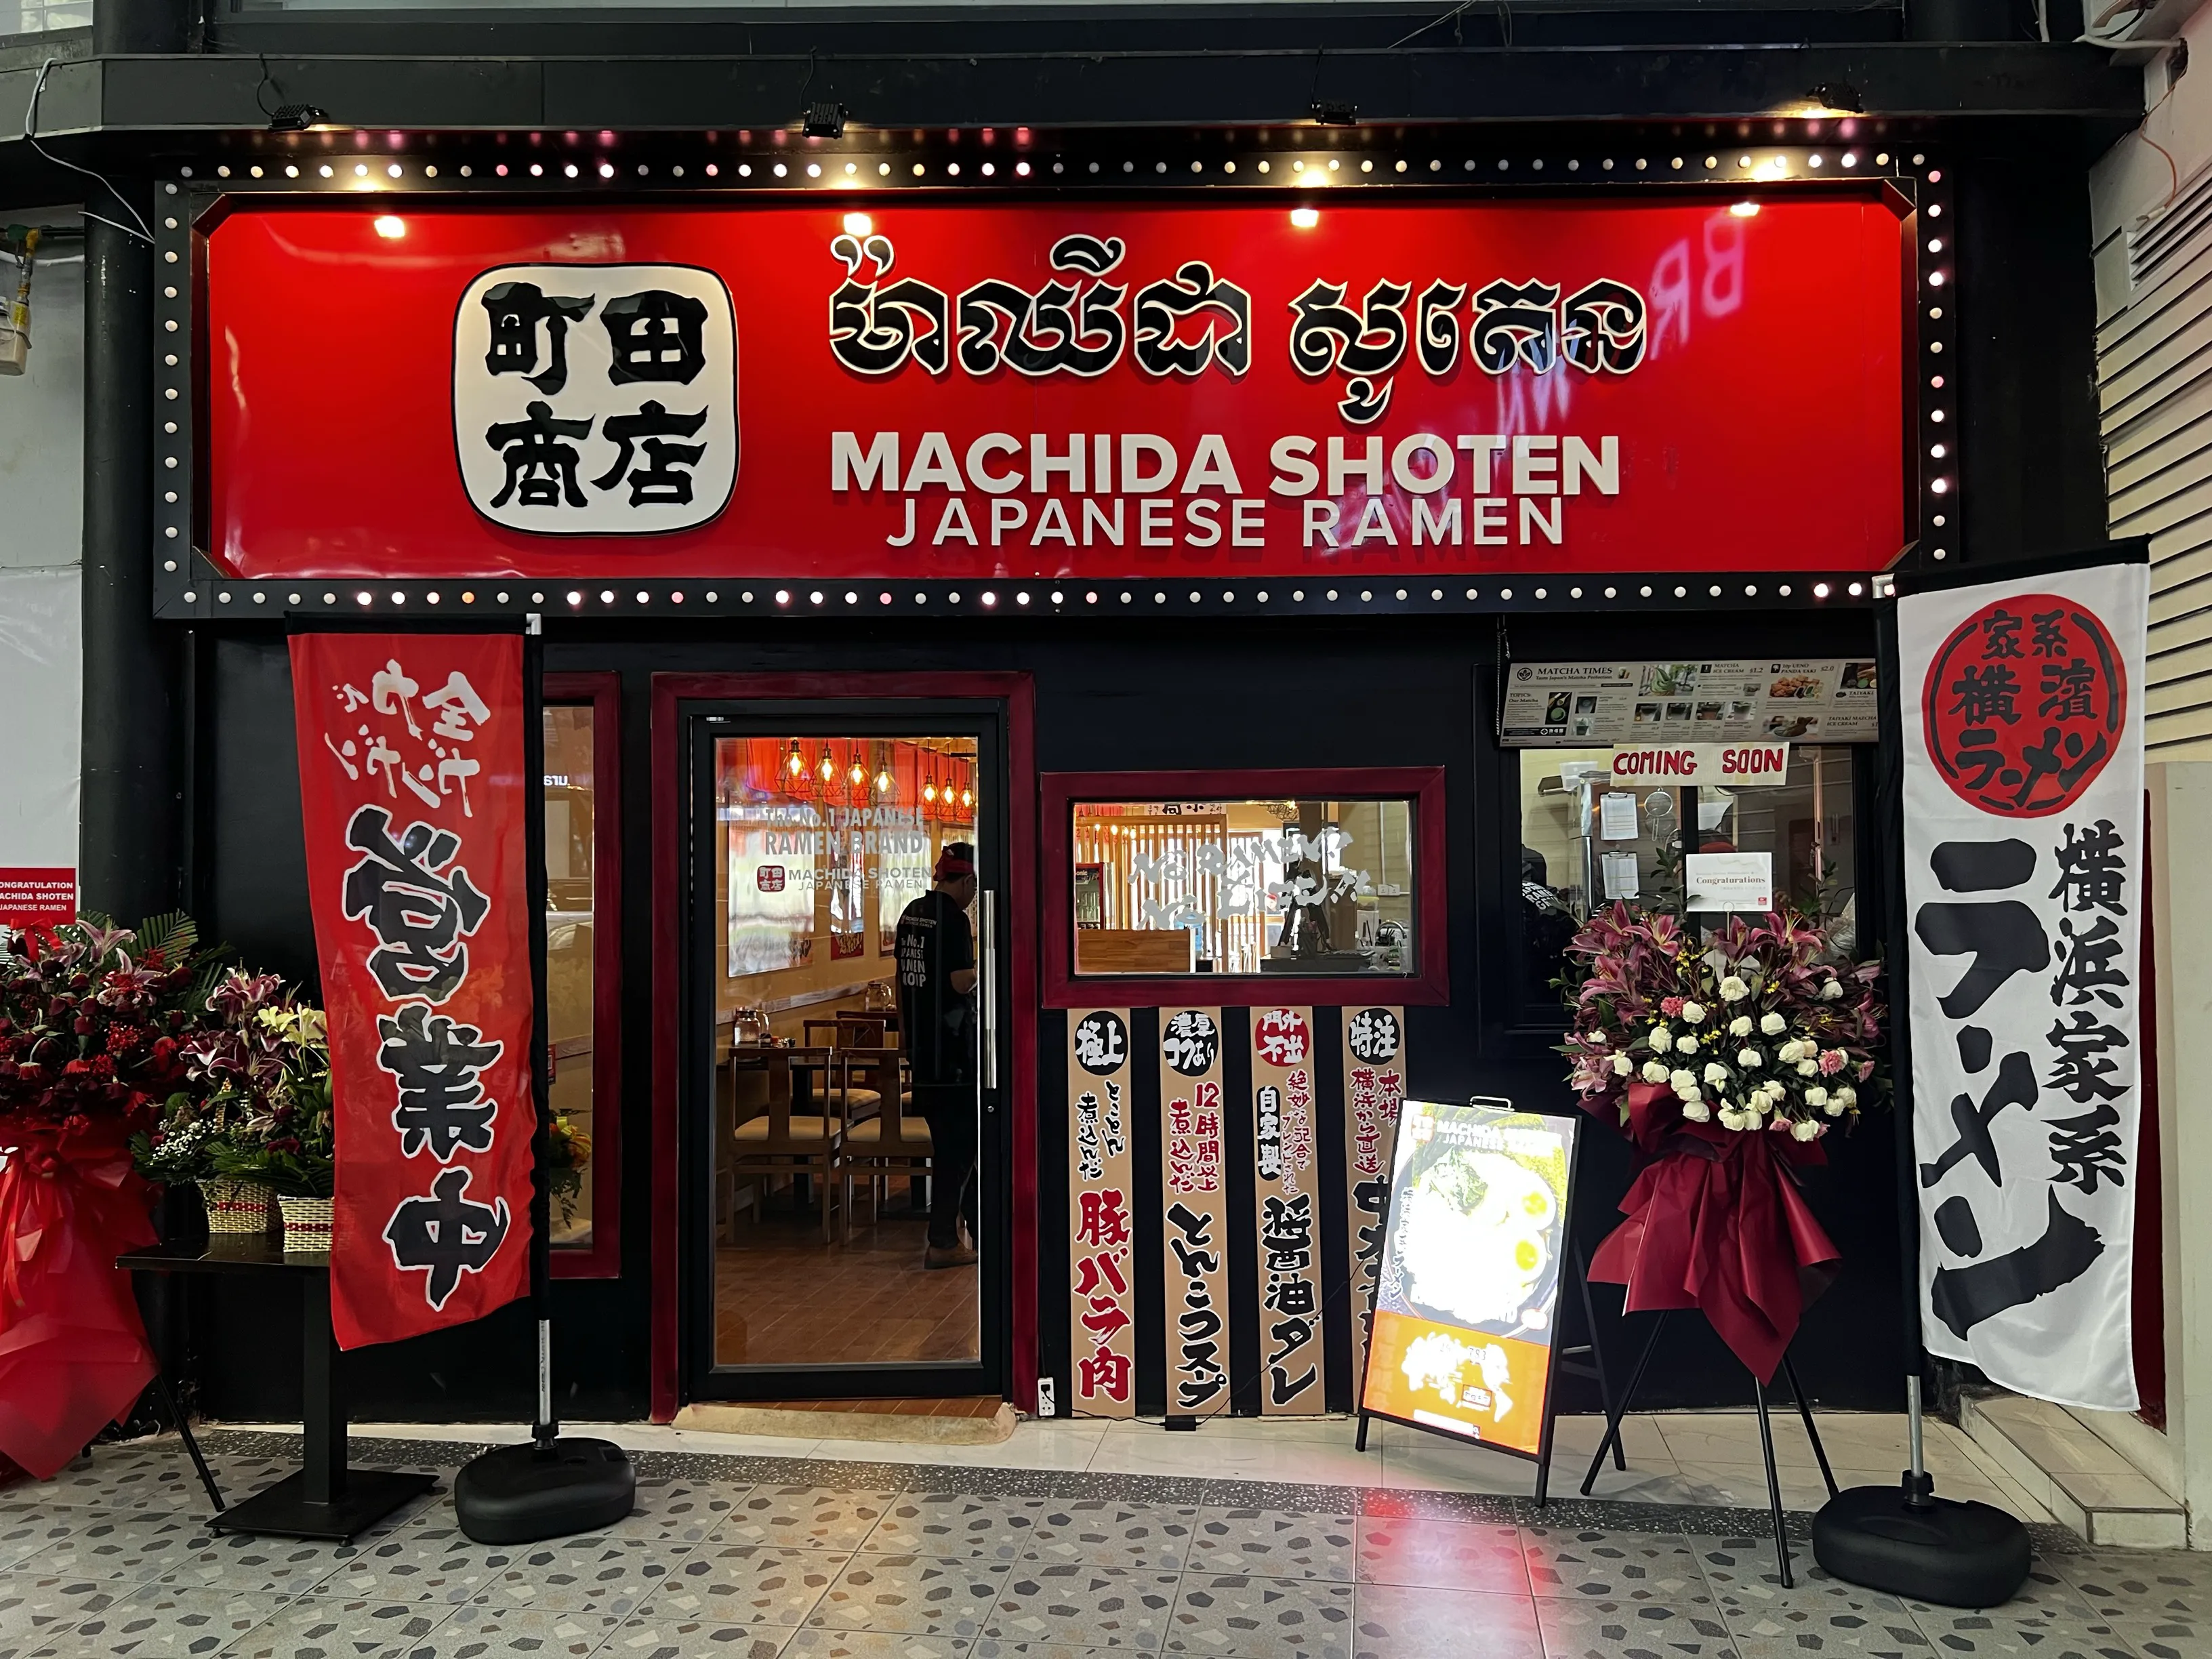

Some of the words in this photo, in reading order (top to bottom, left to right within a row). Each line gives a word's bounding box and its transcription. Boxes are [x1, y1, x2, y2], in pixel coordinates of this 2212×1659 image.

[480, 282, 708, 396] 町田
[485, 400, 709, 509] 商店
[832, 432, 1242, 493] MACHIDA
[1269, 434, 1620, 496] SHOTEN
[886, 499, 1265, 547] JAPANESE
[1303, 497, 1562, 548] RAMEN
[1981, 609, 2069, 660] 家系
[1948, 658, 2098, 726] 横濱
[1613, 749, 1698, 775] COMING
[1722, 748, 1784, 774] SOON
[1954, 726, 2107, 807] ラーメン
[765, 831, 840, 855] RAMEN
[851, 830, 923, 855] BRAND
[799, 806, 835, 827] No.1
[843, 805, 923, 828] JAPANESE
[789, 869, 861, 882] MACHIDA
[868, 867, 931, 879] SHOTEN
[798, 880, 869, 890] JAPANESE
[876, 879, 922, 889] RAMEN
[907, 935, 925, 949] No.1
[1170, 1012, 1215, 1037] 濃厚
[1262, 1010, 1303, 1031] 門外
[1349, 1012, 1398, 1058] 特注
[2040, 819, 2134, 1195] 横浜家系
[1076, 1021, 1124, 1065] 極上
[1257, 1034, 1303, 1063] 不出
[1914, 838, 2106, 1342] ラーメン
[1076, 1092, 1103, 1181] 煮込んだ
[1101, 1080, 1126, 1158] とことん
[1168, 1098, 1195, 1194] 煮込んだ
[1257, 1086, 1282, 1175] 自家製
[1349, 1067, 1386, 1174] 横浜から直送
[1073, 1188, 1134, 1403] 豚バラ肉
